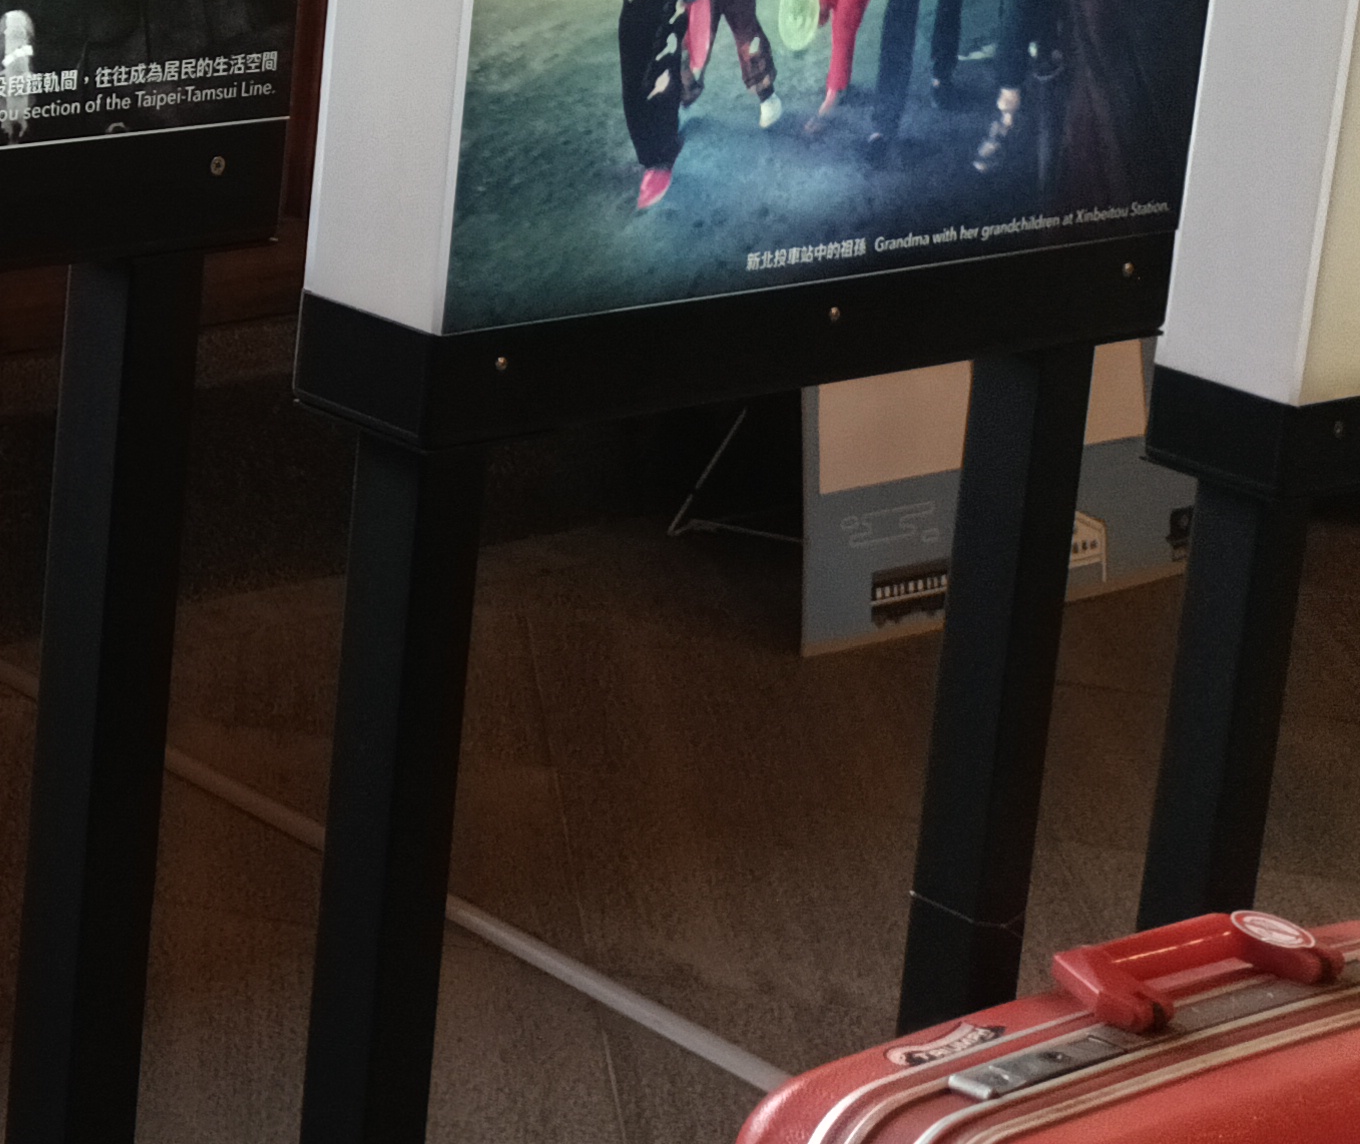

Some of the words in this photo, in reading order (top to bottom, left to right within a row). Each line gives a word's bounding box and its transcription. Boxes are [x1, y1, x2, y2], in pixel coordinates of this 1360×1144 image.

[22, 99, 81, 120] section
[84, 93, 104, 114] of
[106, 92, 132, 111] the
[135, 81, 238, 111] Taipei-Tamsui
[241, 79, 277, 98] Line.
[745, 237, 867, 272] 新北投車站中的祖孫
[874, 231, 930, 253] Grandma
[932, 224, 958, 245] with
[959, 223, 979, 241] her
[981, 212, 1061, 242] grandchildren
[1062, 212, 1074, 227] at
[1075, 204, 1129, 225] Xinbeitou
